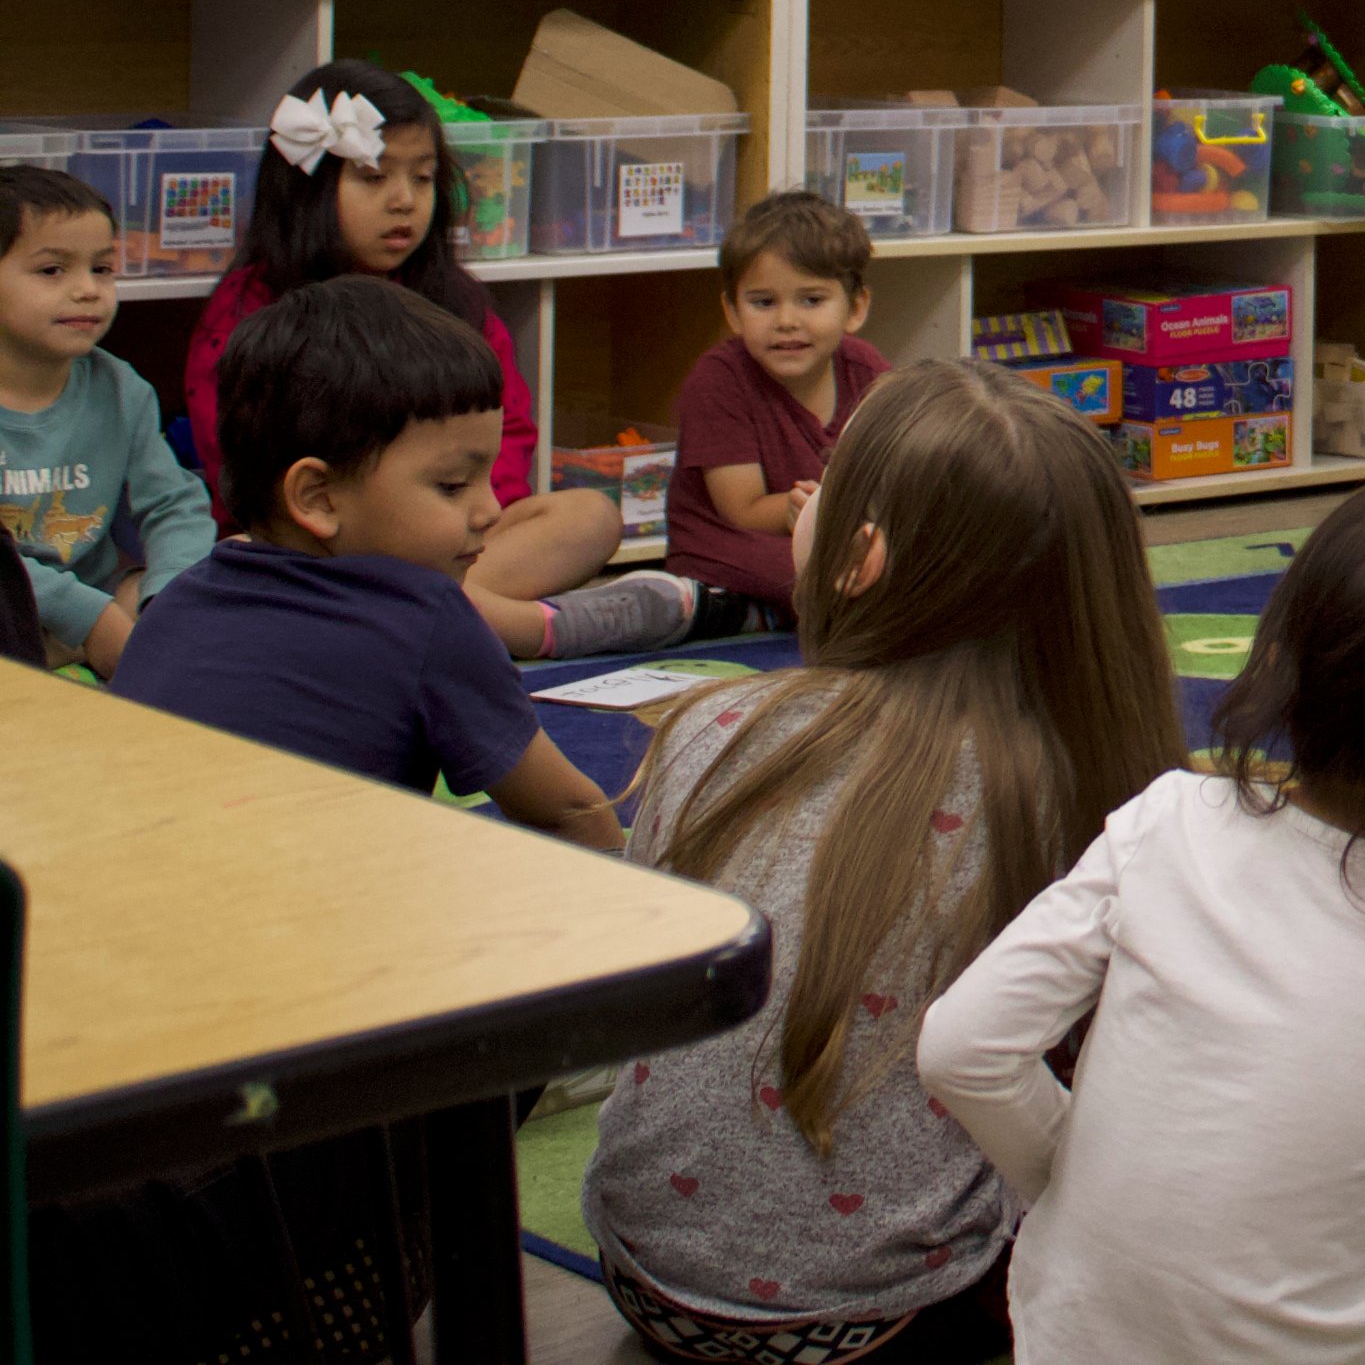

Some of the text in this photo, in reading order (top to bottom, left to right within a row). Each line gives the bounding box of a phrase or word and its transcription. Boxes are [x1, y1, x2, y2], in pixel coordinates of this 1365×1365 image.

[1161, 313, 1229, 333] Ocean Animals
[1168, 387, 1197, 410] 48
[1171, 438, 1220, 453] Busy Bugs
[0, 463, 90, 495] NIMALS
